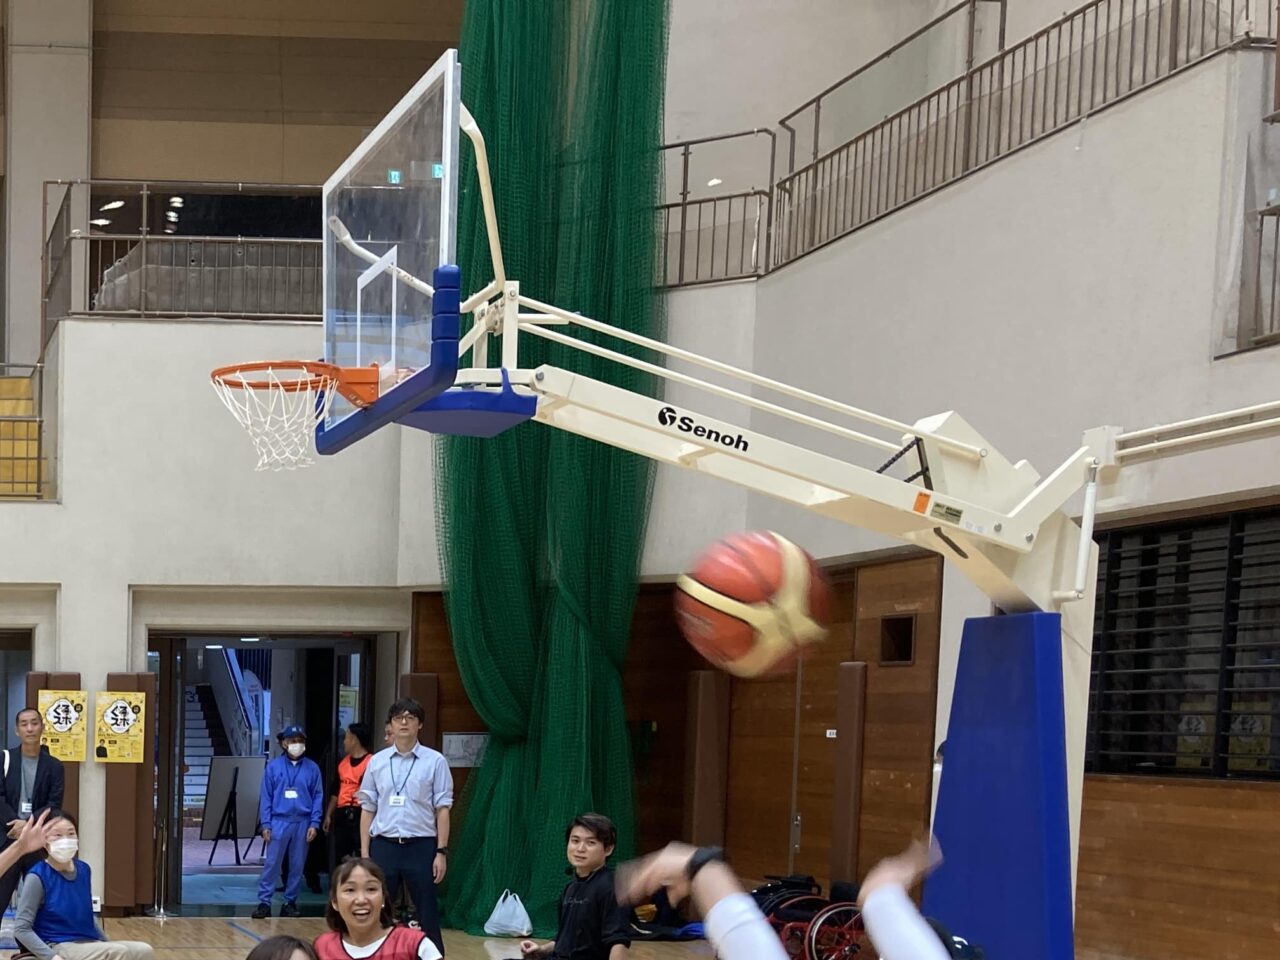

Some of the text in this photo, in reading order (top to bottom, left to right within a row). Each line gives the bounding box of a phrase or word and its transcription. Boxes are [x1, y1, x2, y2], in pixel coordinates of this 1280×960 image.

[677, 416, 749, 452] Senoh
[53, 704, 71, 716] くる
[111, 705, 129, 717] くる
